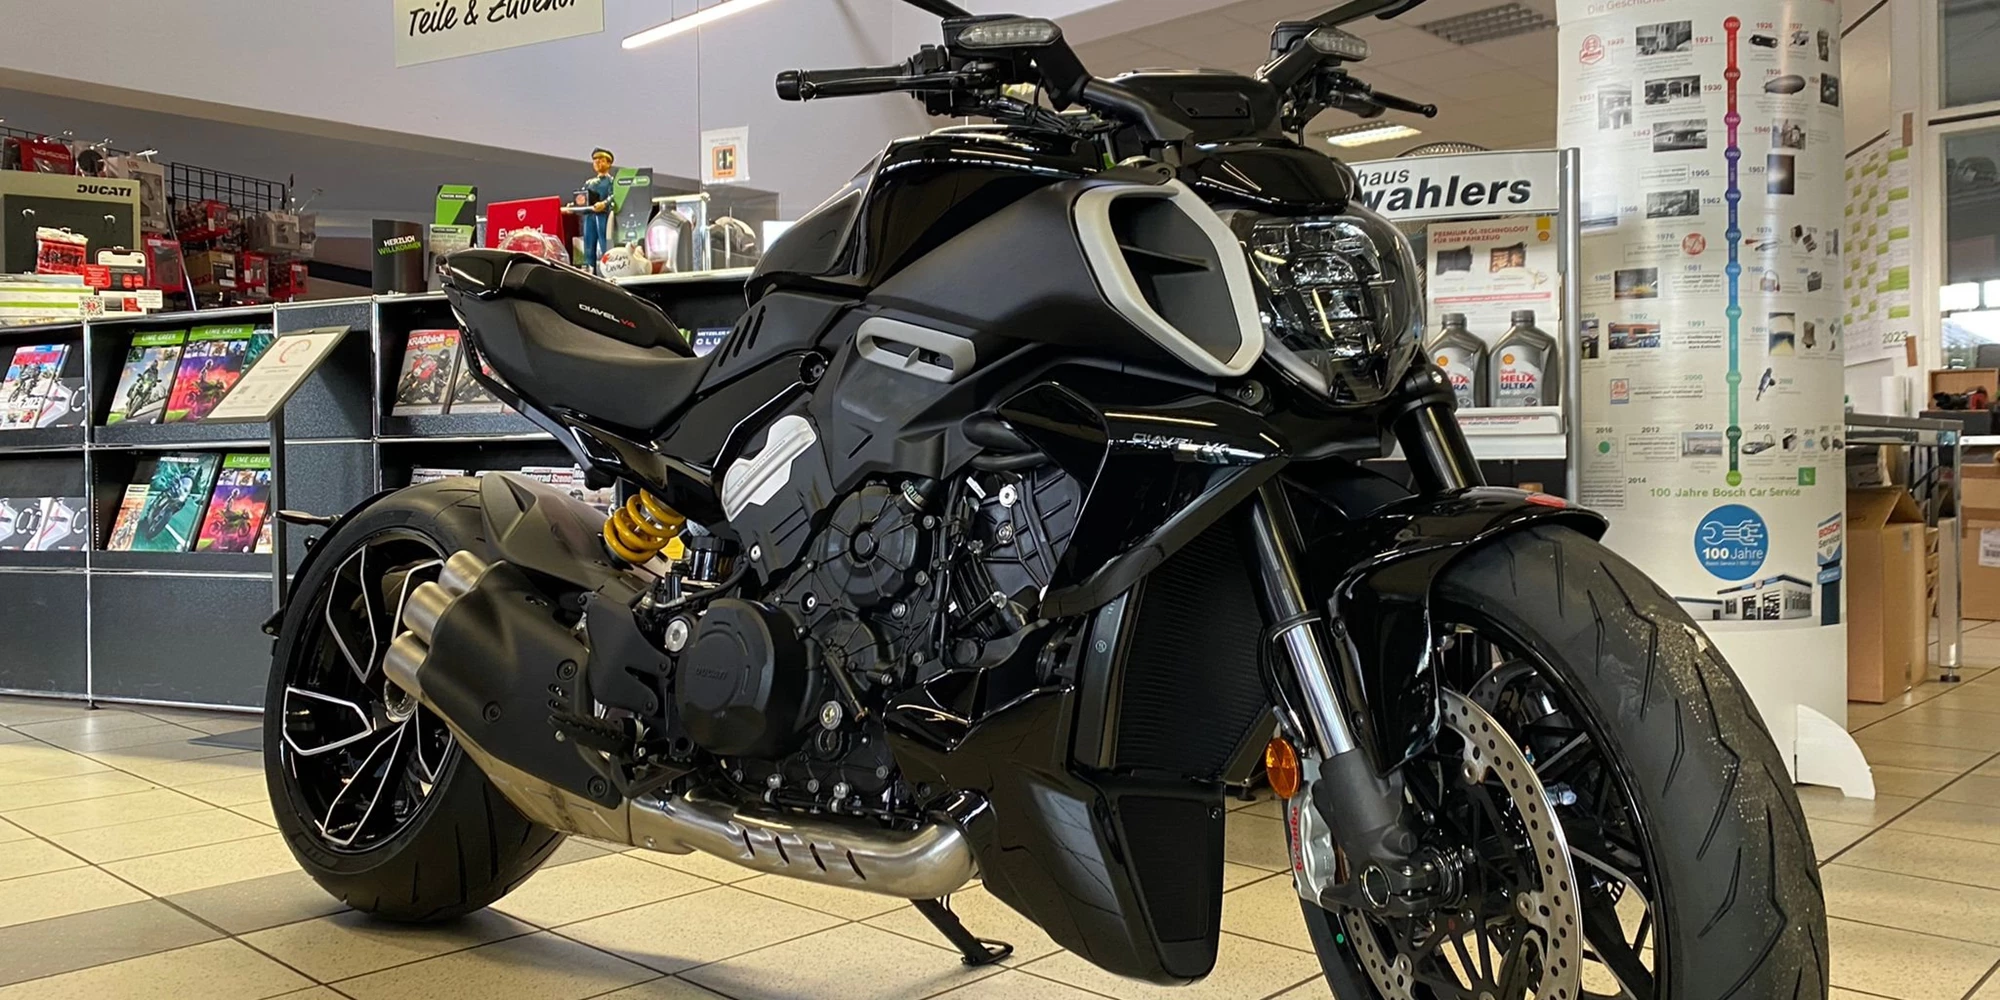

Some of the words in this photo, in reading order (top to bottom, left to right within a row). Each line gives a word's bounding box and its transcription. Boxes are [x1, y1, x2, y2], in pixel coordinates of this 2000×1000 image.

[409, 2, 457, 37] Teile
[463, 0, 478, 26] &
[1358, 169, 1410, 187] haus
[76, 183, 132, 197] DUCATI
[1433, 229, 1467, 238] PREMIUM
[1433, 236, 1447, 244] FÜR
[1462, 234, 1500, 242] FAHRZEUG
[578, 303, 620, 323] DIAVEL
[1630, 312, 1648, 320] 1992
[1882, 330, 1908, 344] 2023
[1500, 374, 1537, 382] HELIX
[1500, 382, 1535, 390] ULTRA
[1695, 423, 1714, 431] 2012
[1650, 488, 1671, 497] 100
[1675, 488, 1708, 497] Jahre
[1713, 487, 1746, 497] Bosch
[1749, 487, 1766, 496] Car
[1769, 486, 1801, 497] Service
[1818, 523, 1841, 539] BOSCH
[1703, 547, 1729, 560] 100
[1730, 547, 1764, 560] Jahre
